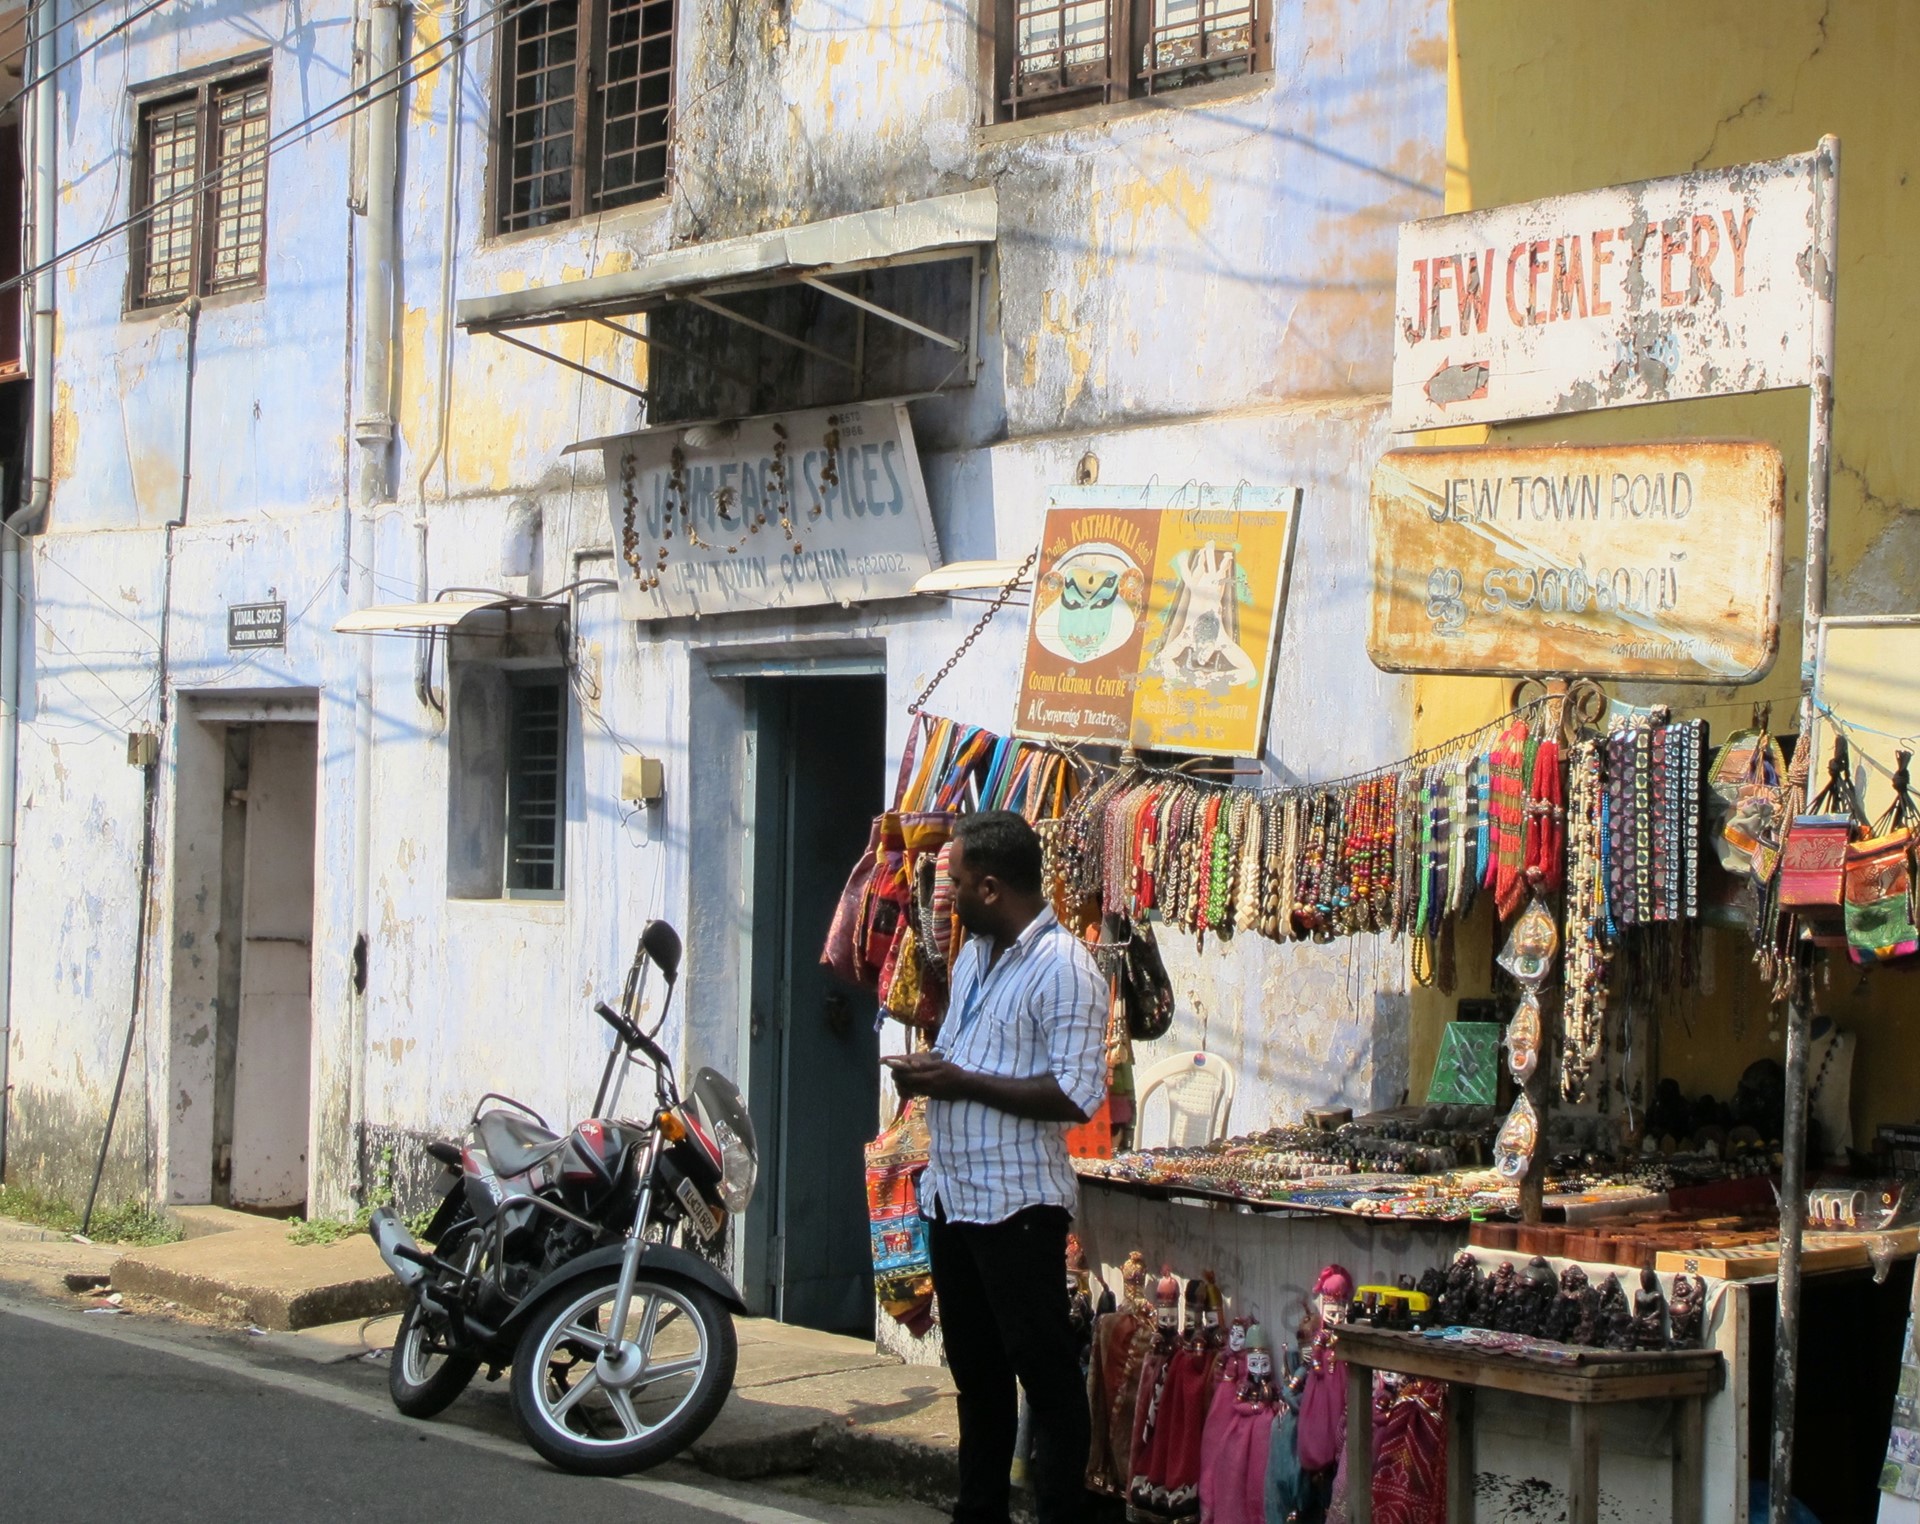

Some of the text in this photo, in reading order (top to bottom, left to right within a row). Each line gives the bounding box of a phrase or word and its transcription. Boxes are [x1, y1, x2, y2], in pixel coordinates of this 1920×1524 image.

[1403, 248, 1496, 344] JEW
[803, 440, 904, 523] SPICES
[1427, 471, 1692, 524] JEW TOWN ROAD
[1070, 513, 1141, 549] KATHAKALI
[672, 562, 709, 595] JEW
[233, 608, 282, 626] VIMAL SPICES
[1095, 675, 1127, 697] CENTRE
